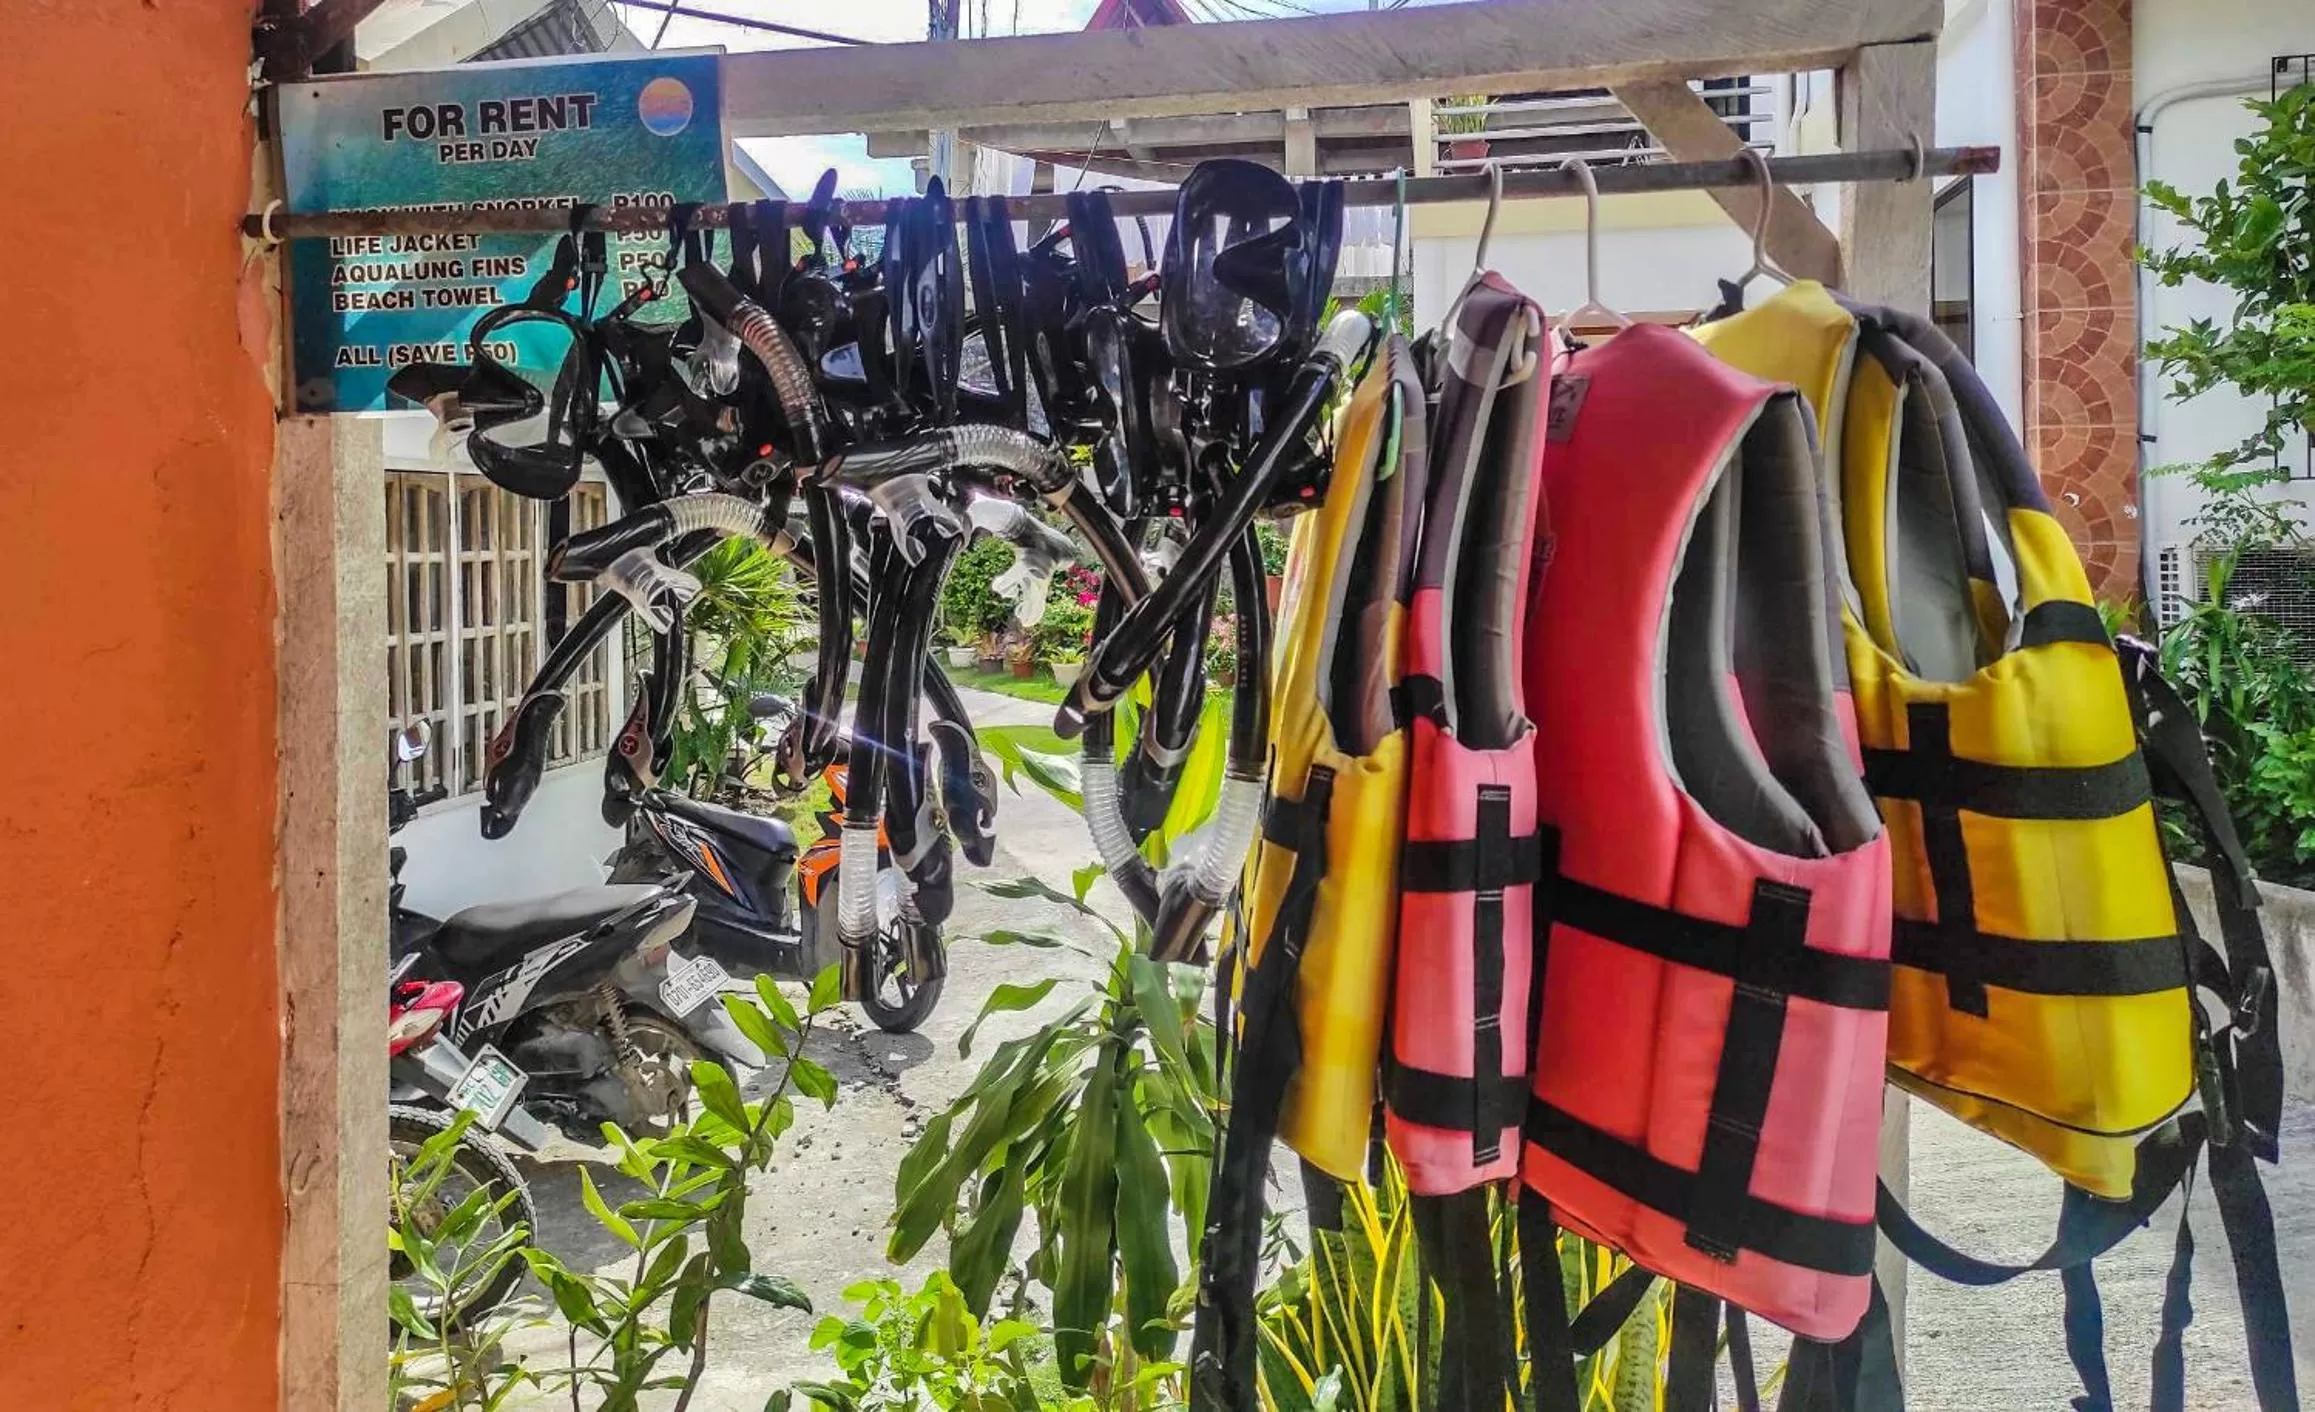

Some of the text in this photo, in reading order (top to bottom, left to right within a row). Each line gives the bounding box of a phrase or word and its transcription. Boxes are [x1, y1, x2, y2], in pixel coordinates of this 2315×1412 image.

[381, 92, 597, 142] FOR RENT
[439, 137, 539, 164] PER DAY
[330, 233, 481, 256] LIFE JACKET
[332, 257, 527, 284] AQUALUNG FINS
[618, 250, 667, 271] P50
[333, 285, 504, 312] BEACH TOWEL
[622, 280, 671, 300] P0
[335, 346, 382, 367] ALL
[387, 343, 459, 368] (SAVE
